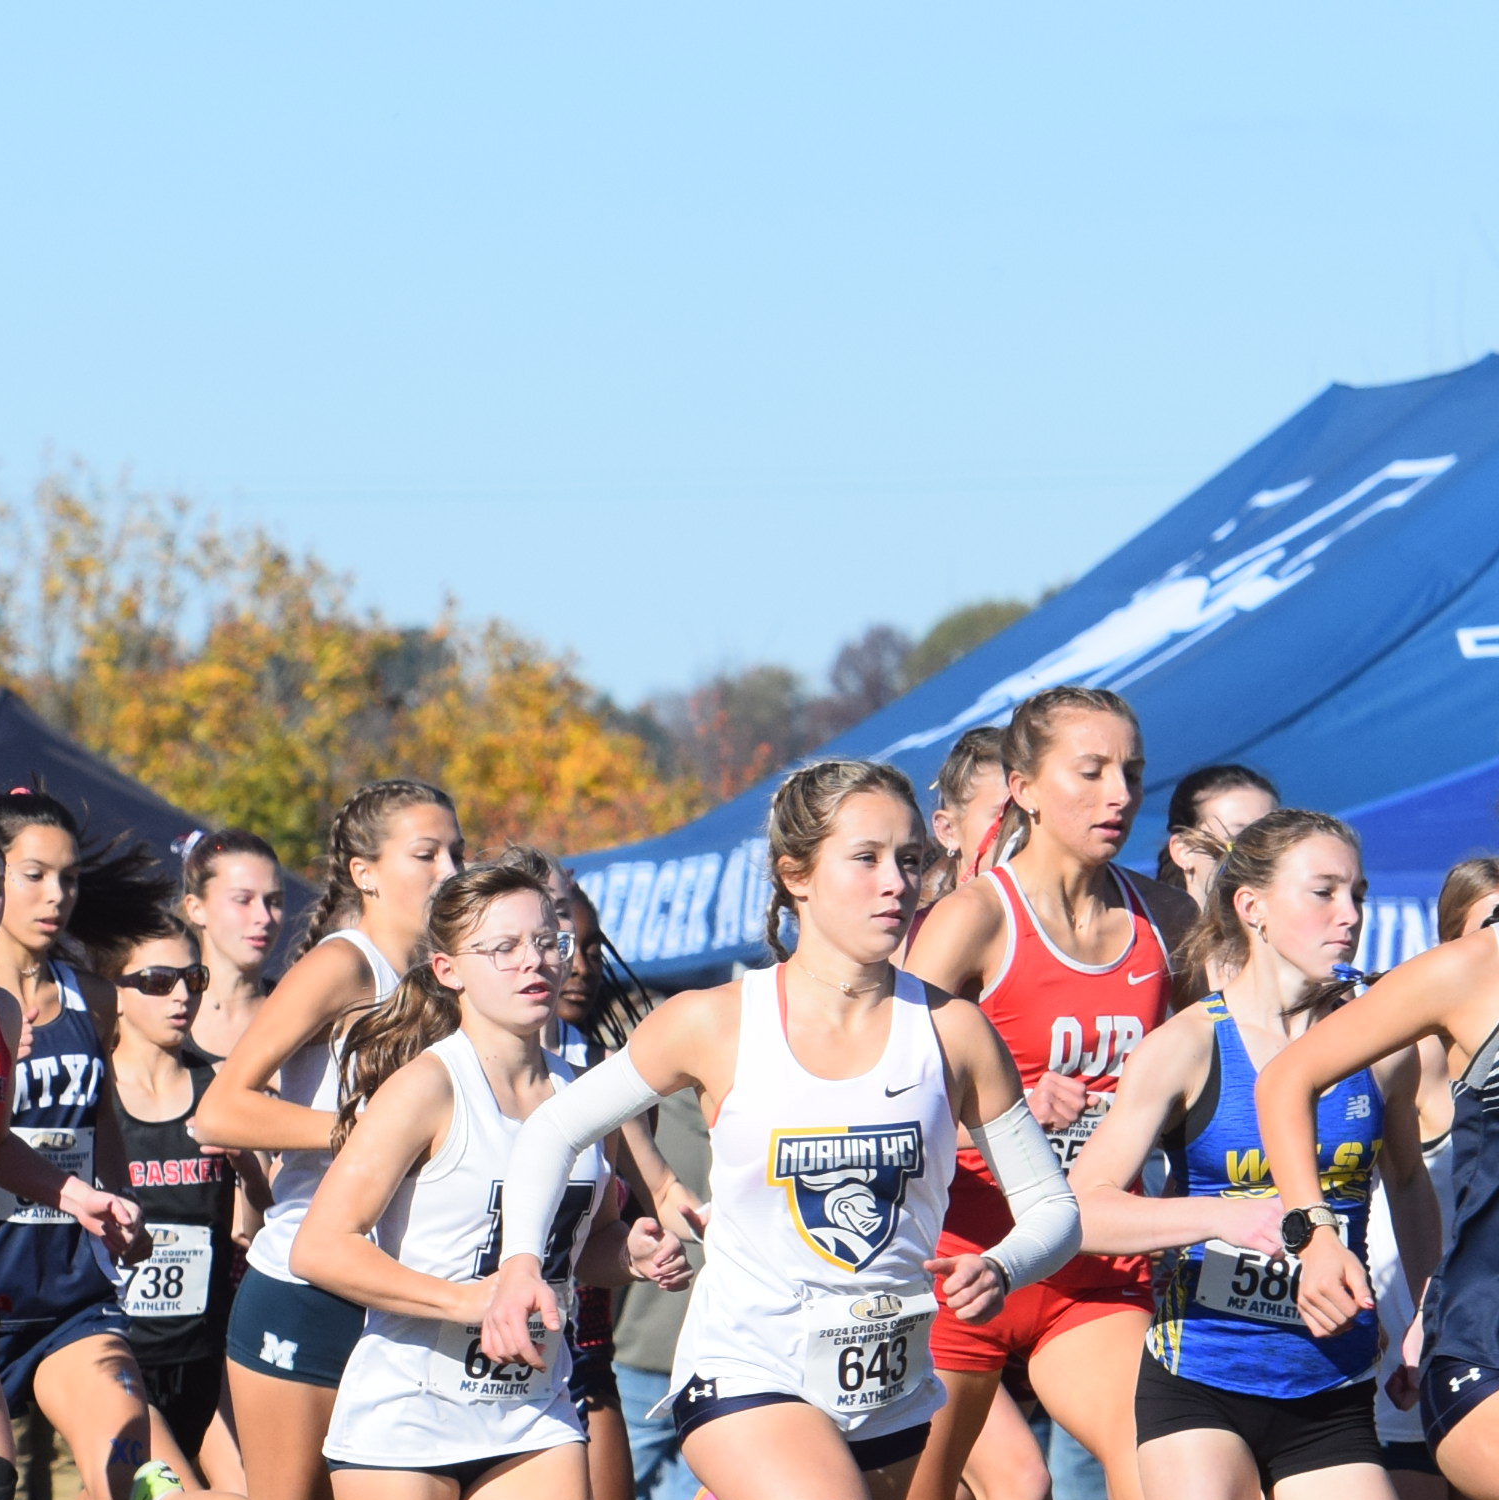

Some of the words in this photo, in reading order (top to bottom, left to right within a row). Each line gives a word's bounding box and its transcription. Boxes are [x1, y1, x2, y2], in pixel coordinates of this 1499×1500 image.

[780, 1137, 877, 1174] NORWIN
[881, 1134, 914, 1169] XC
[162, 1250, 203, 1258] COUNTRY
[119, 1265, 184, 1299] 738
[1231, 1253, 1302, 1301] 58
[133, 1301, 181, 1311] ATHLETIC
[819, 1328, 848, 1338] 2024
[851, 1323, 888, 1335] CROSS
[890, 1313, 931, 1330] COUNTRY
[833, 1325, 916, 1346] CHAMPIONSHIPS
[259, 1331, 299, 1371] M
[837, 1336, 908, 1391] 643
[480, 1382, 530, 1395] ATHLETIC
[859, 1382, 905, 1406] ATHLETIC
